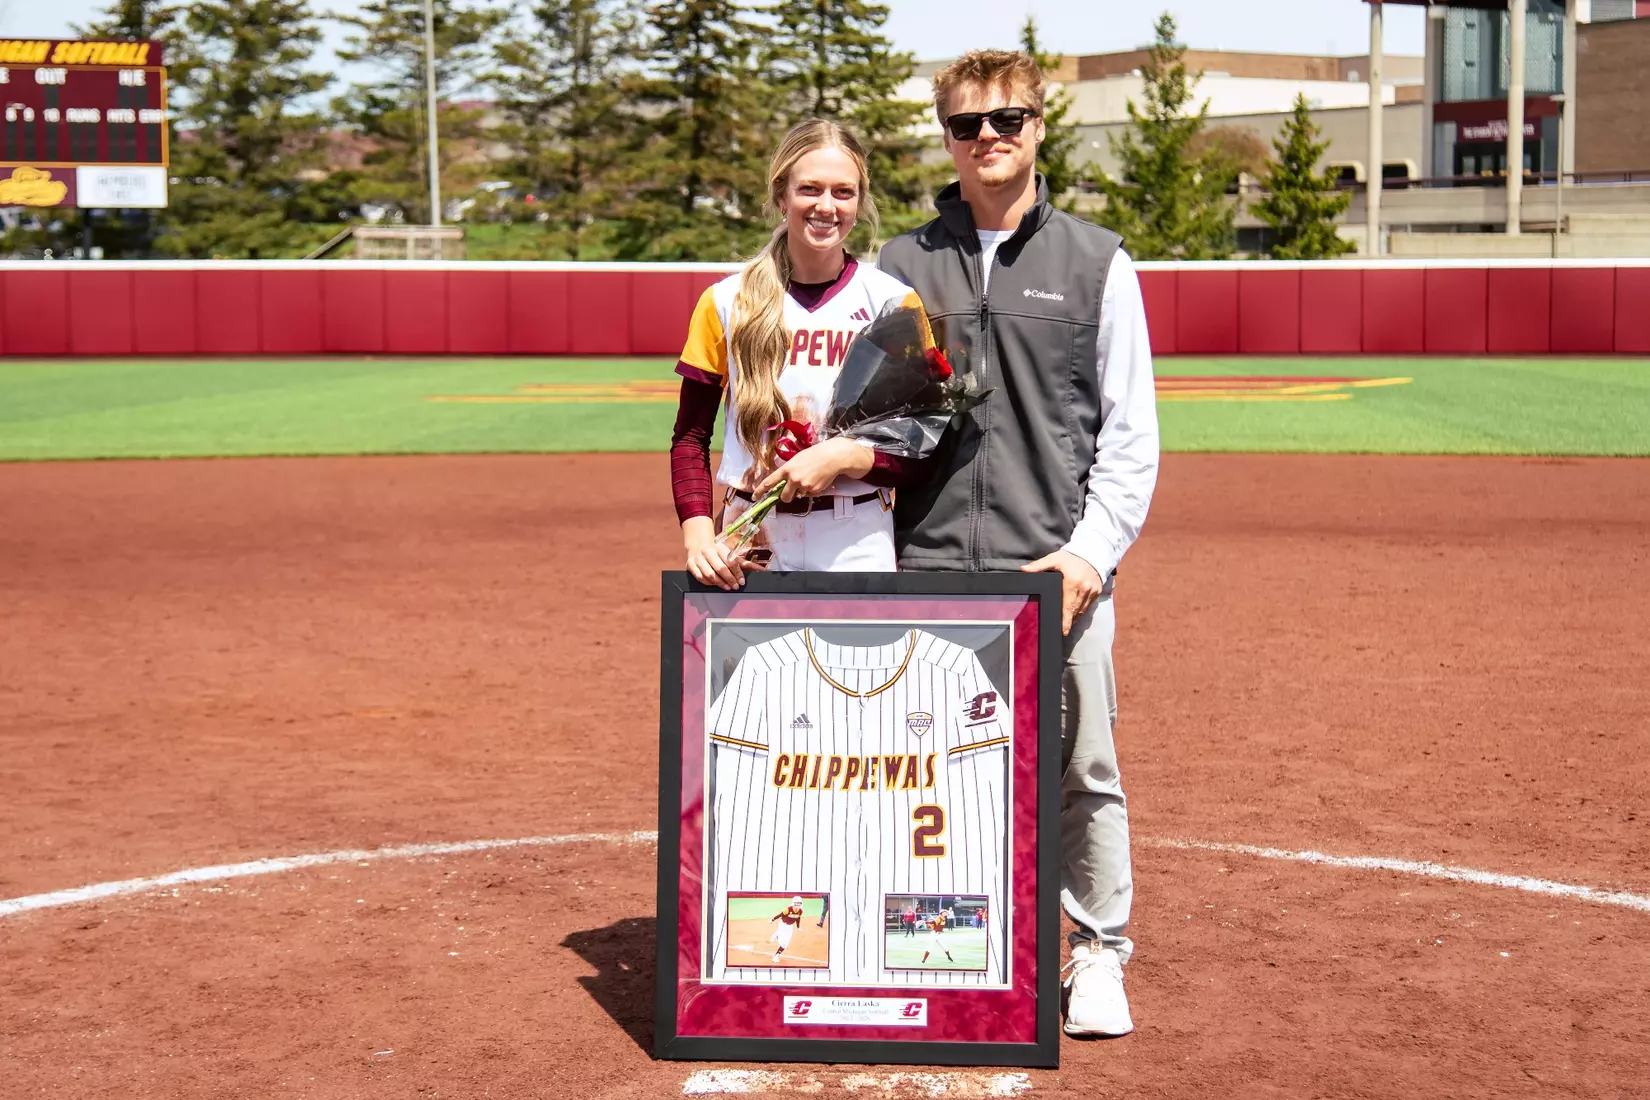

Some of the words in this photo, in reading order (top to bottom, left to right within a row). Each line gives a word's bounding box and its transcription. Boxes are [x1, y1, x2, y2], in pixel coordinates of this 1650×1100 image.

[51, 42, 149, 65] SOFTBALL
[35, 67, 68, 85] OUT
[66, 108, 101, 123] RUNS
[106, 108, 136, 123] HITS
[1031, 289, 1064, 301] Columbia
[789, 722, 814, 730] adidas
[773, 752, 939, 792] CHIPPEWAS
[912, 803, 946, 859] 2
